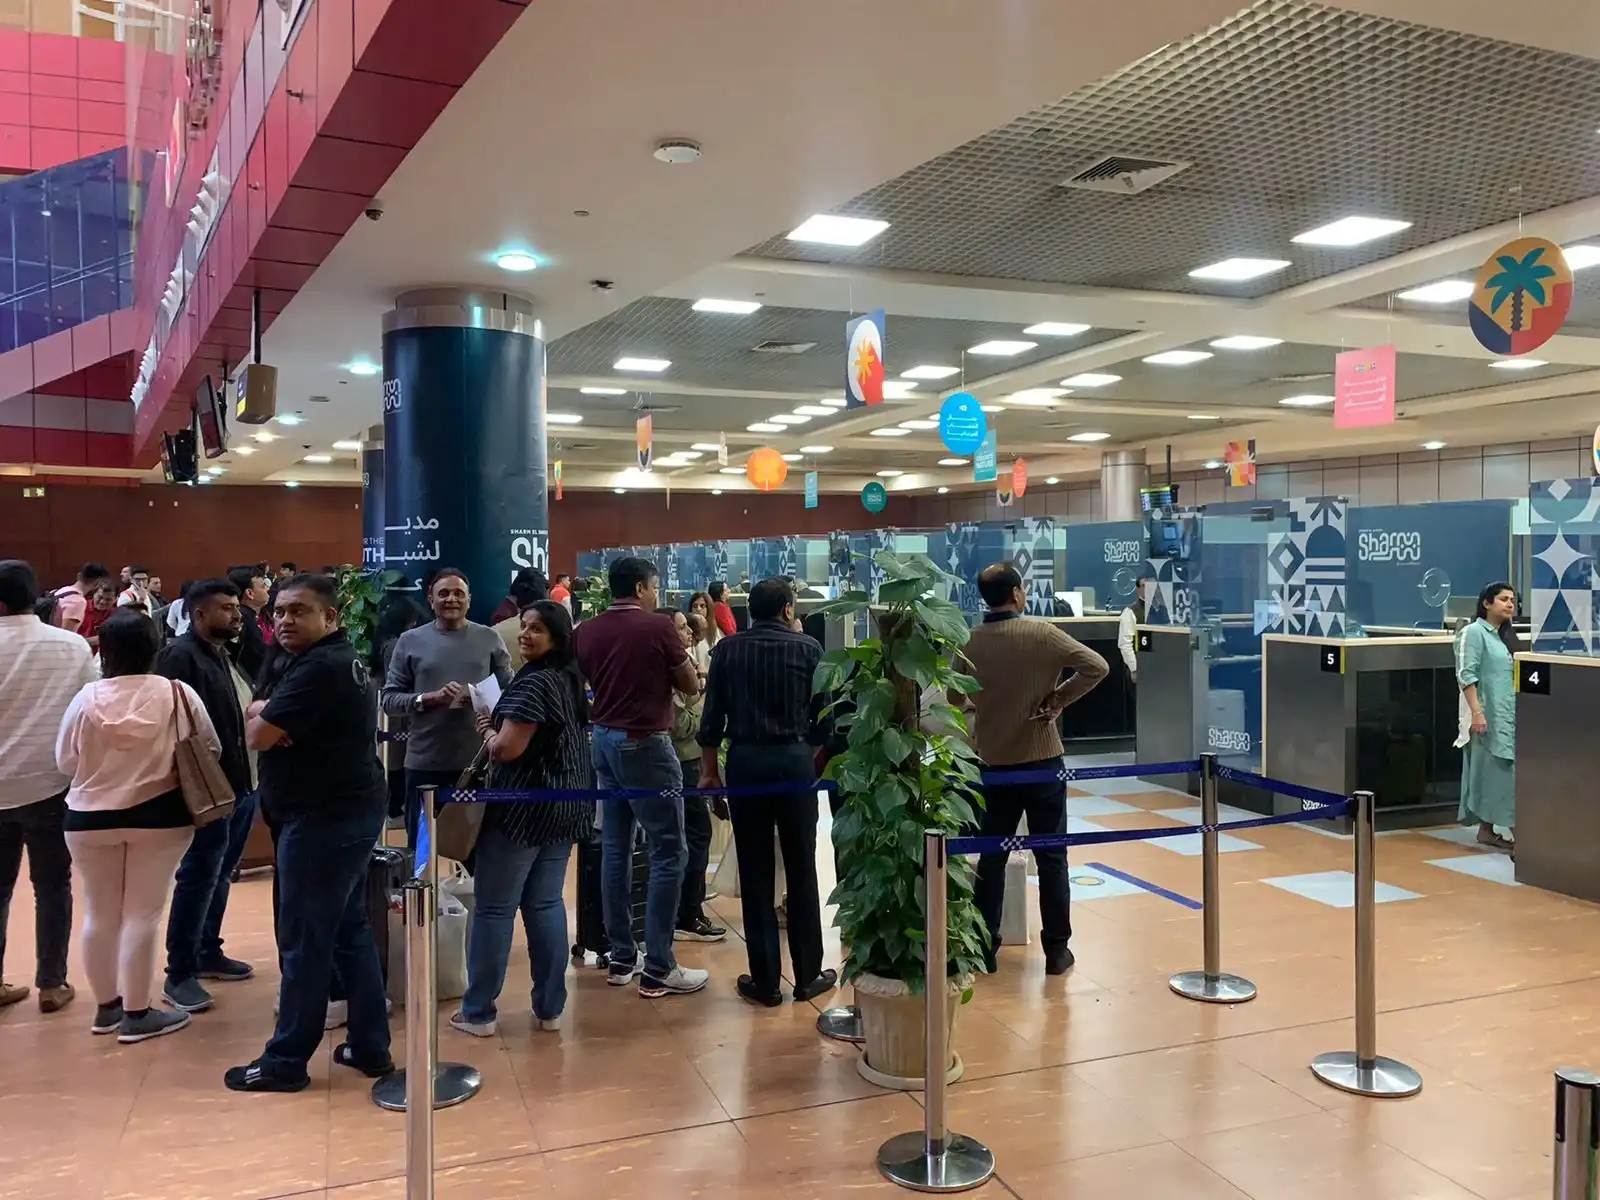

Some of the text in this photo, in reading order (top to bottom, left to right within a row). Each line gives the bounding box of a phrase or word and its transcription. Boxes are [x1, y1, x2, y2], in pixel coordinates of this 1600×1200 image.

[369, 536, 385, 545] THE
[511, 536, 549, 580] Sh
[1141, 635, 1148, 646] 6
[1327, 653, 1335, 665] 5
[1528, 671, 1540, 685] 4
